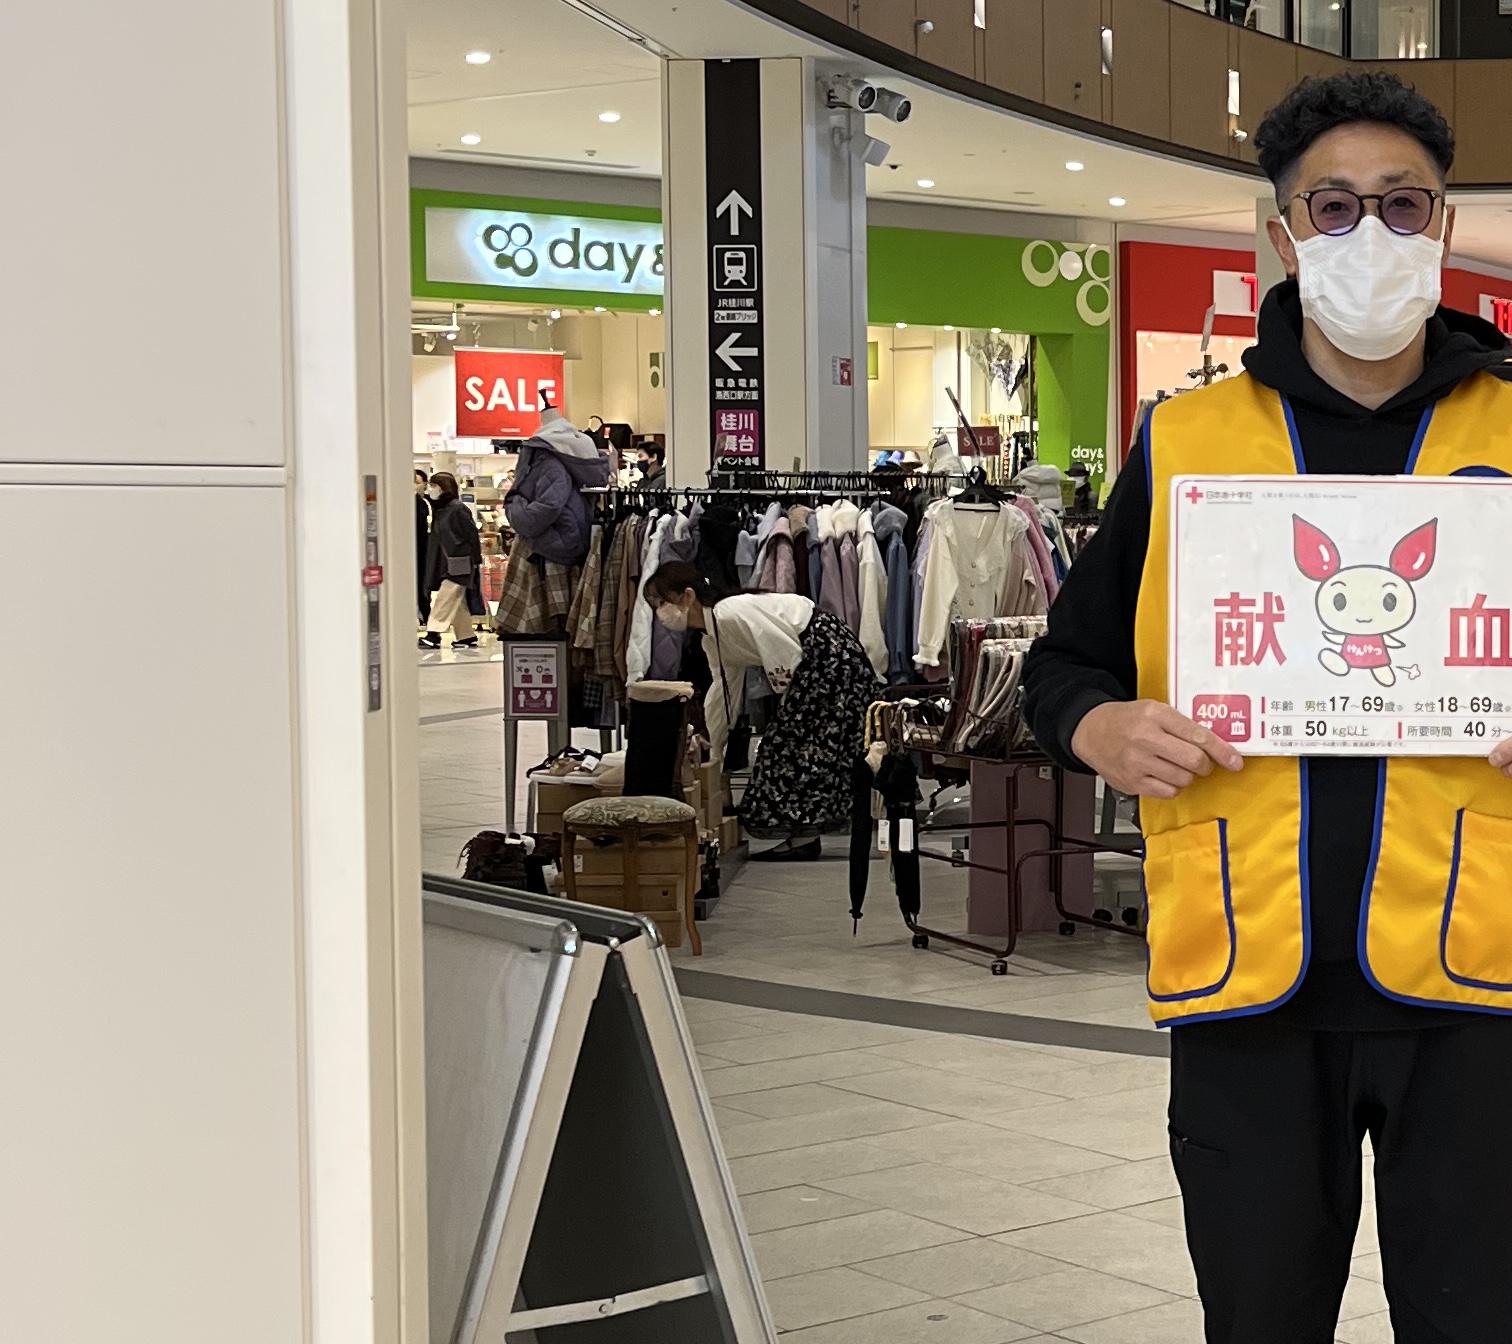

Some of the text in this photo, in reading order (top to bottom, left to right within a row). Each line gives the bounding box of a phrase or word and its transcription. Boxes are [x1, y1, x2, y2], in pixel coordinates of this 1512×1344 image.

[717, 297, 755, 308] JR桂川駅
[464, 375, 556, 413] SALE
[720, 412, 754, 431] 桂川
[1213, 591, 1288, 668] 献
[1346, 643, 1383, 657] けんけつ
[1196, 703, 1247, 720] 400 mL
[1270, 700, 1294, 712] 年齢
[1270, 724, 1293, 737] 体重
[1304, 720, 1328, 737] 50
[1406, 725, 1453, 738] 所要時間
[1463, 720, 1486, 738] 40
